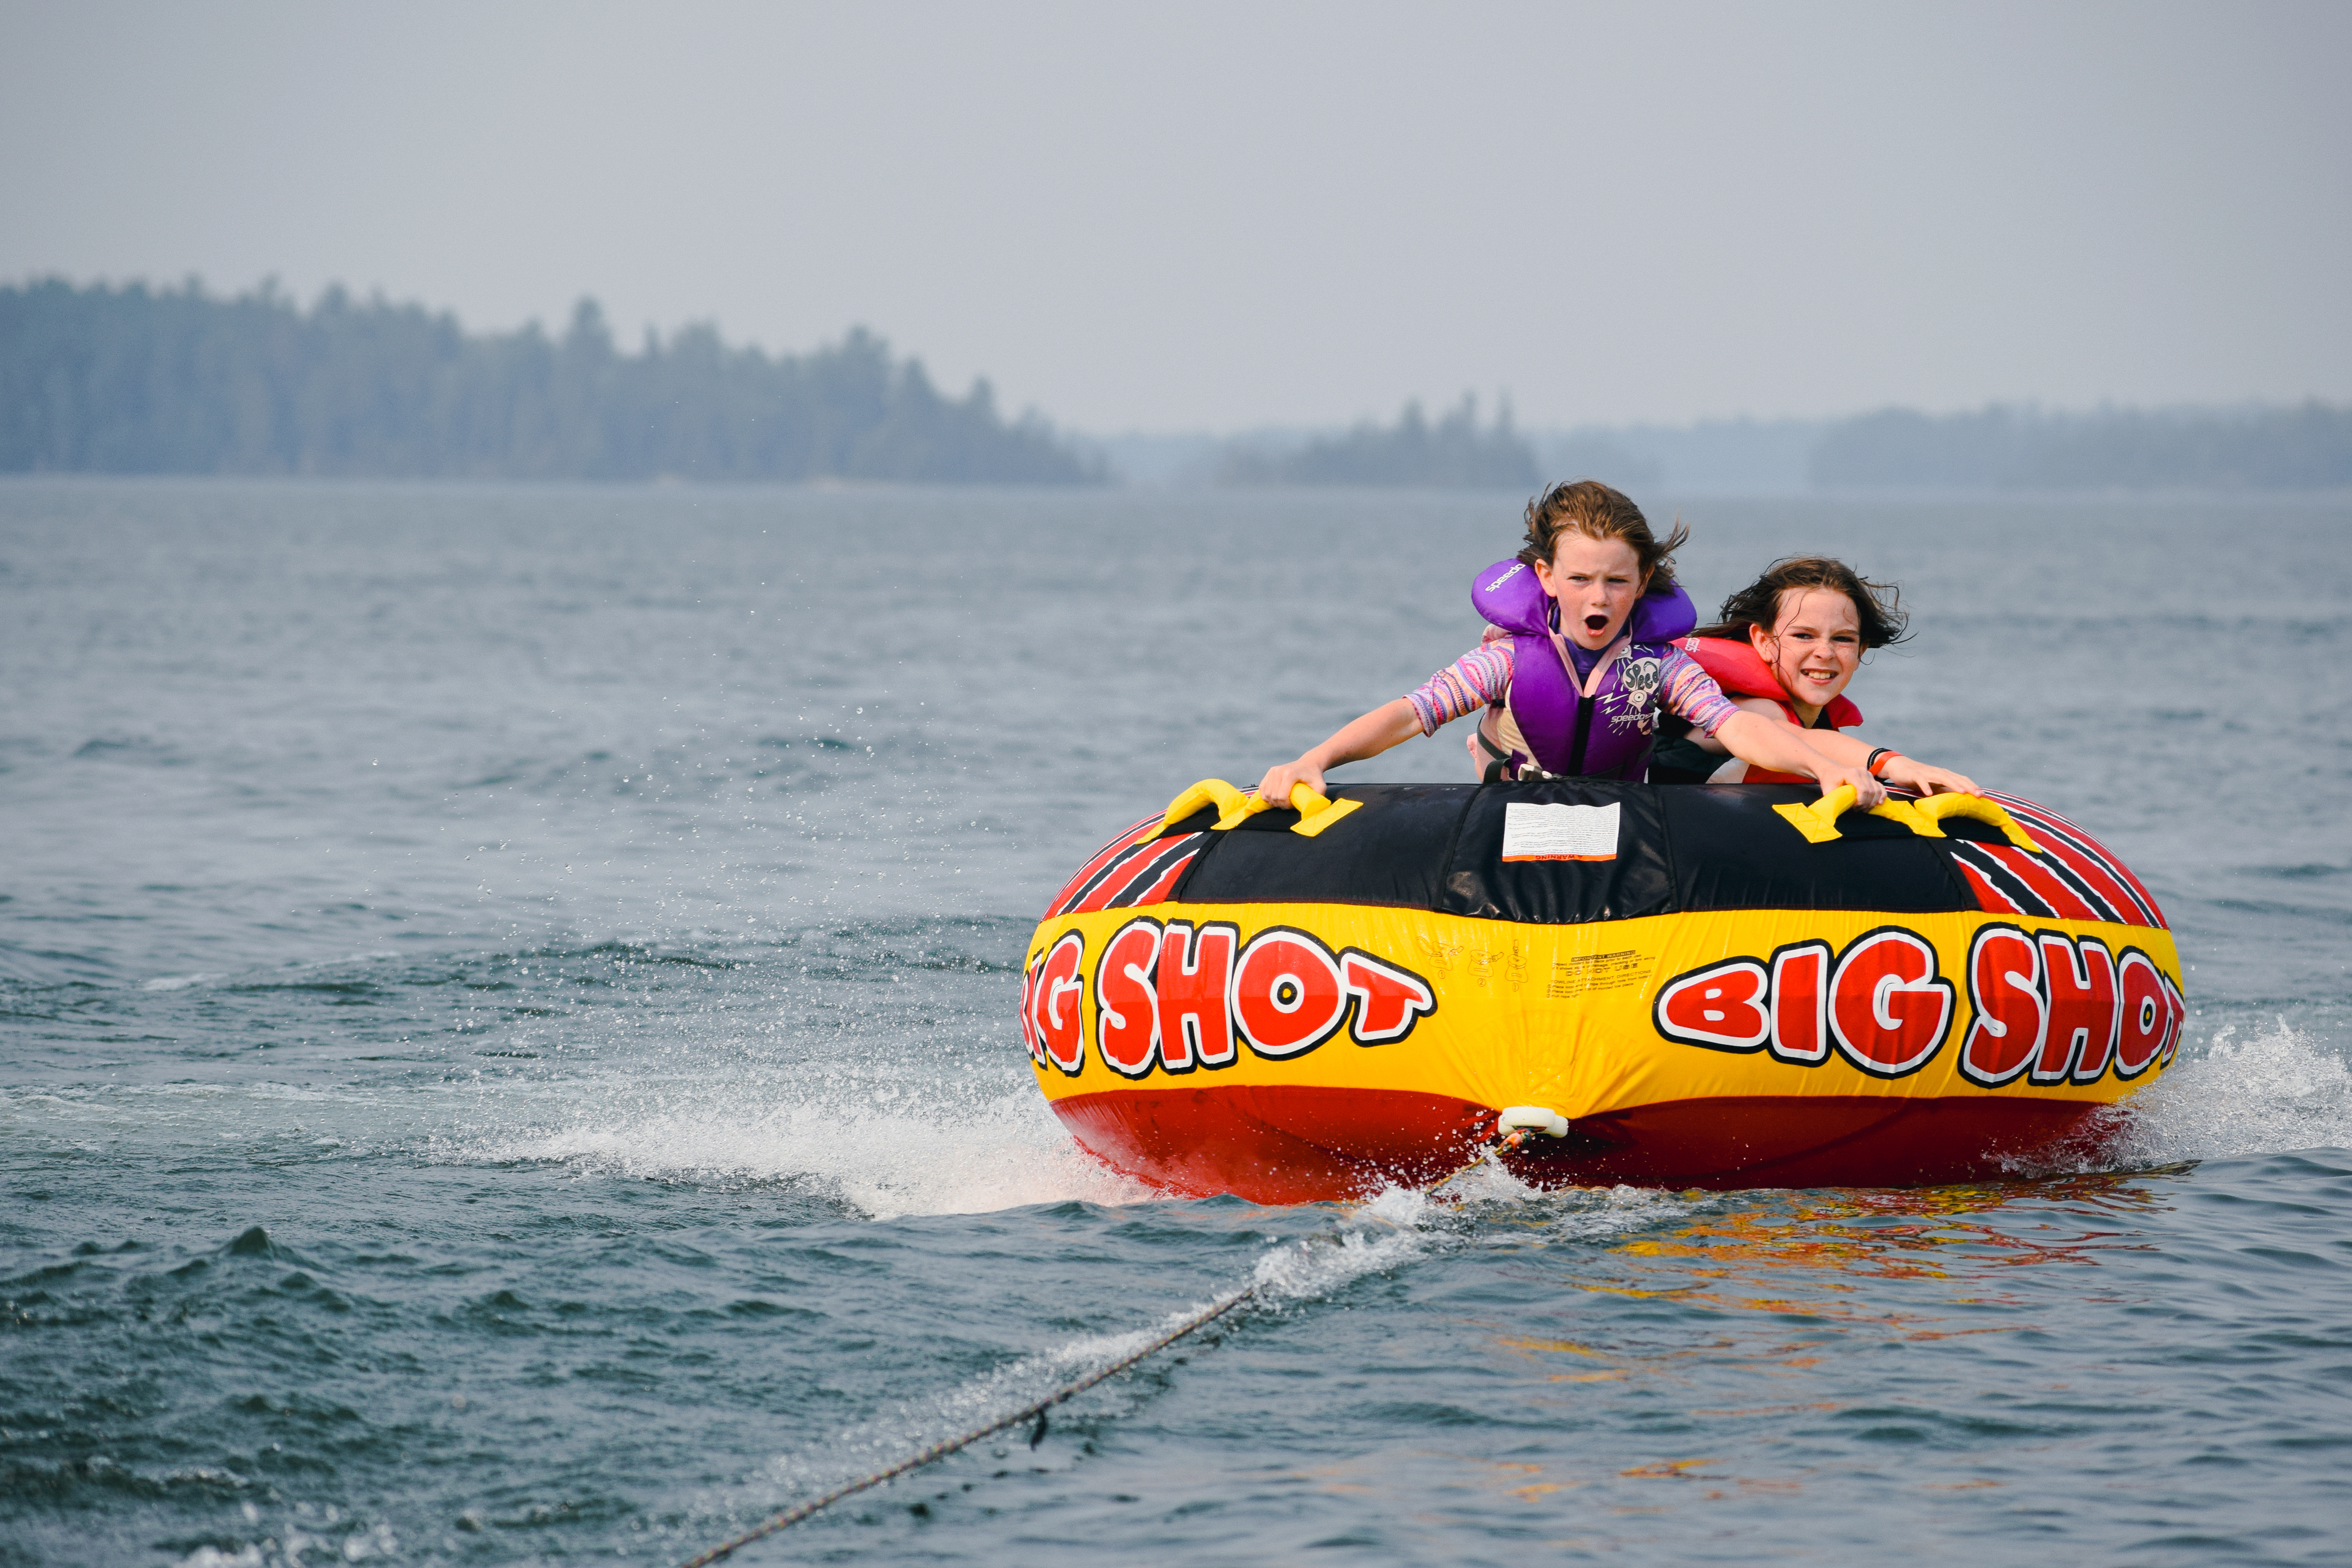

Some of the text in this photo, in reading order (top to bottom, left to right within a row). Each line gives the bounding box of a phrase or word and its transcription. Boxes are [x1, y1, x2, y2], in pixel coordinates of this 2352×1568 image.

[1485, 563, 1525, 592] speedo
[1611, 713, 1645, 723] speedo
[1614, 963, 1638, 971] USE
[1617, 970, 1651, 978] DIRECTIONS
[1094, 915, 1438, 1080] SHOT
[1651, 924, 1957, 1079] BIG
